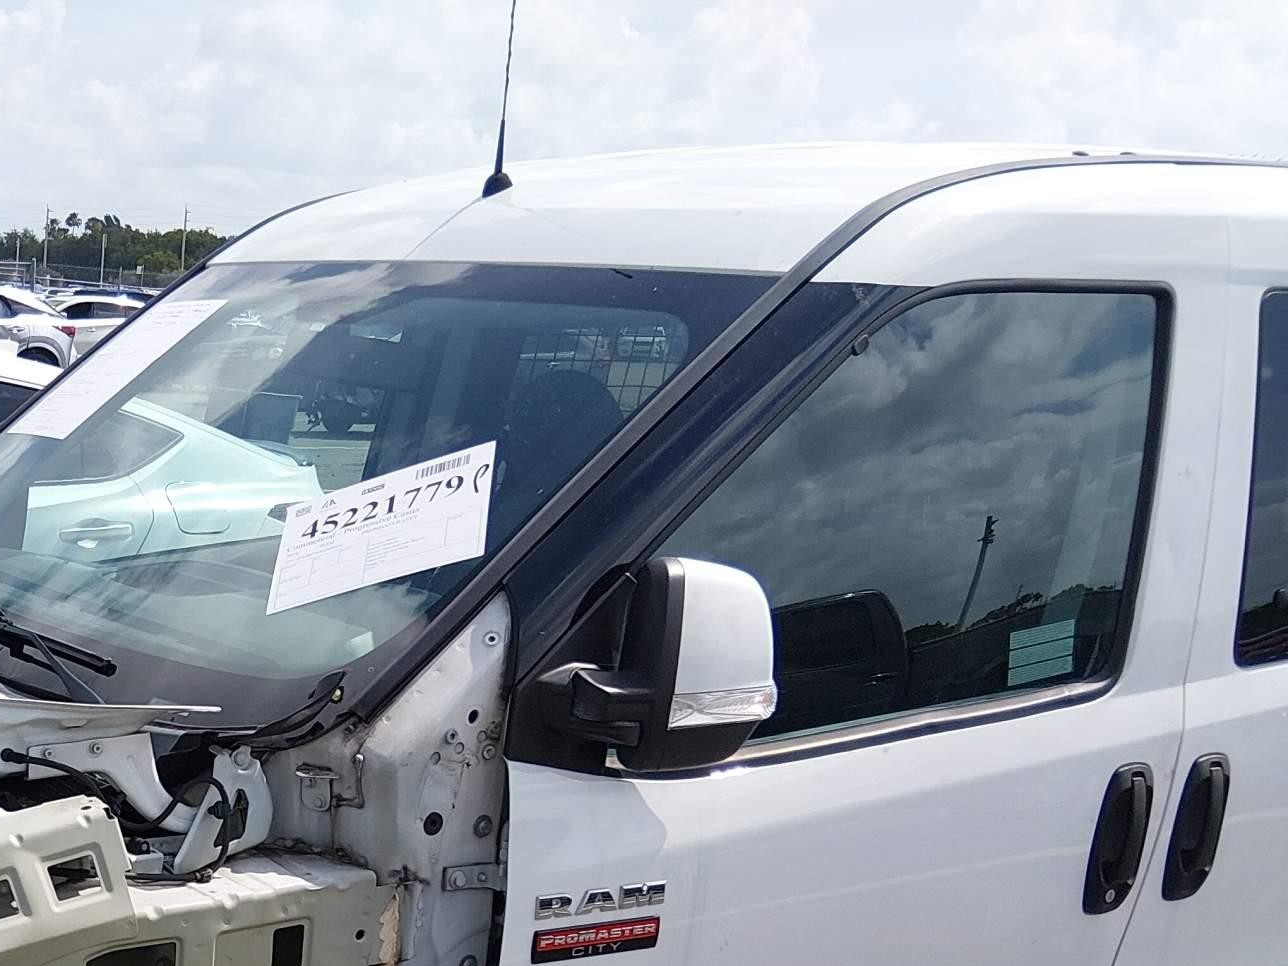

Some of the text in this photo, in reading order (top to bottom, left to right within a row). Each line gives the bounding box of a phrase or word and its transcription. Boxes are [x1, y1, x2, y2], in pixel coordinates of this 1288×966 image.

[300, 475, 465, 539] 45221779
[534, 880, 667, 920] RAM
[572, 942, 623, 957] CITY
